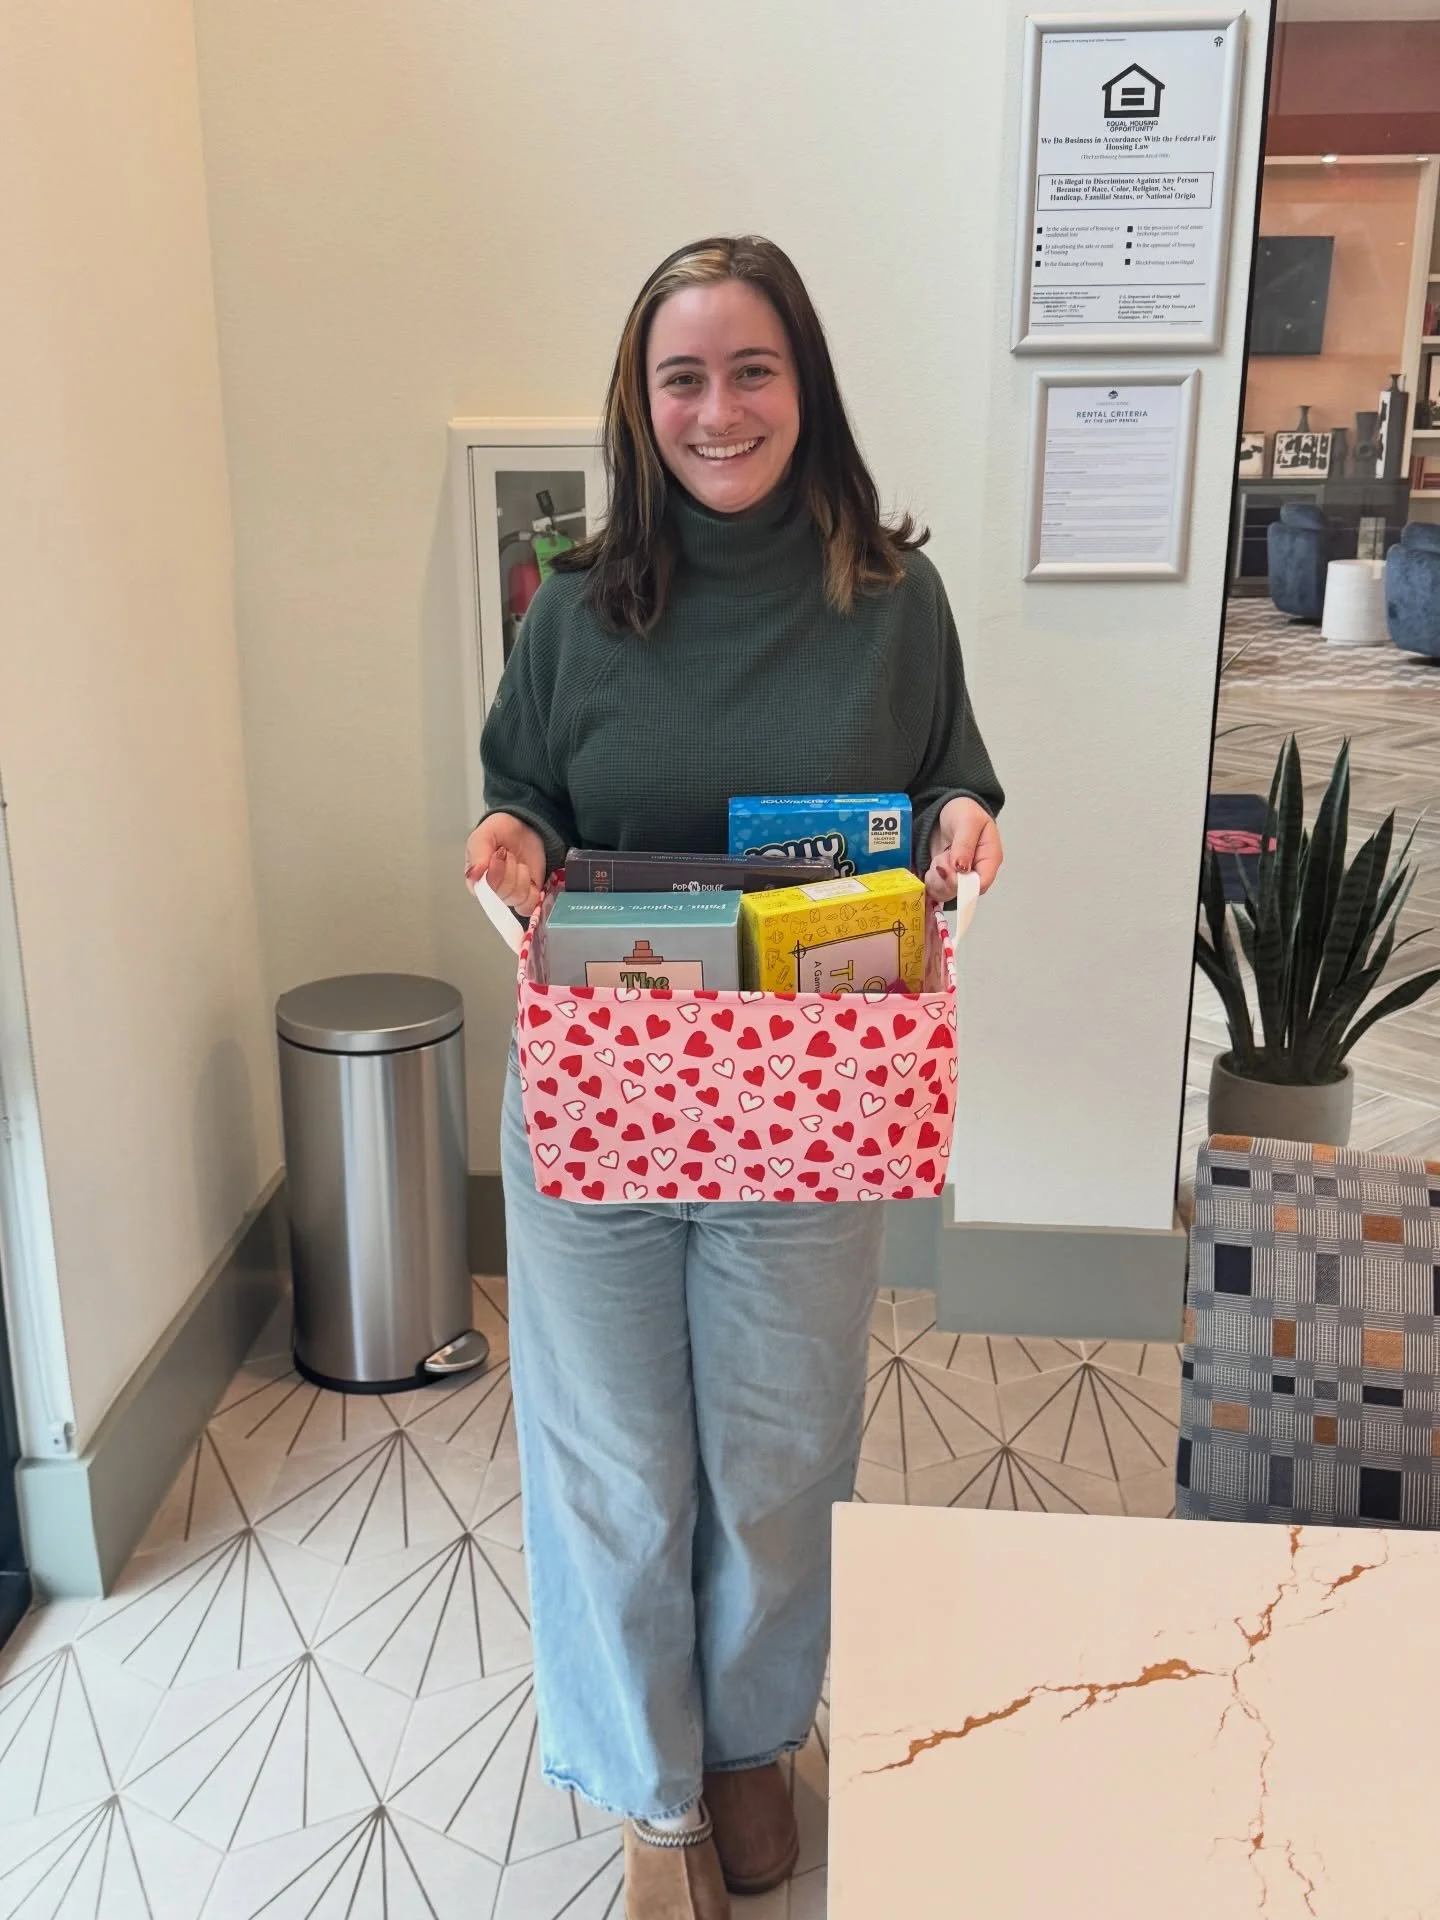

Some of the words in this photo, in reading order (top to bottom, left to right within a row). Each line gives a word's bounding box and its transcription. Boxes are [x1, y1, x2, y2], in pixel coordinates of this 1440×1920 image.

[1105, 143, 1133, 151] Housing
[1136, 177, 1160, 185] Against
[1163, 177, 1174, 185] Any
[1110, 410, 1148, 418] CRITERIA
[871, 817, 898, 831] 20
[595, 870, 607, 878] 30
[620, 972, 669, 990] The
